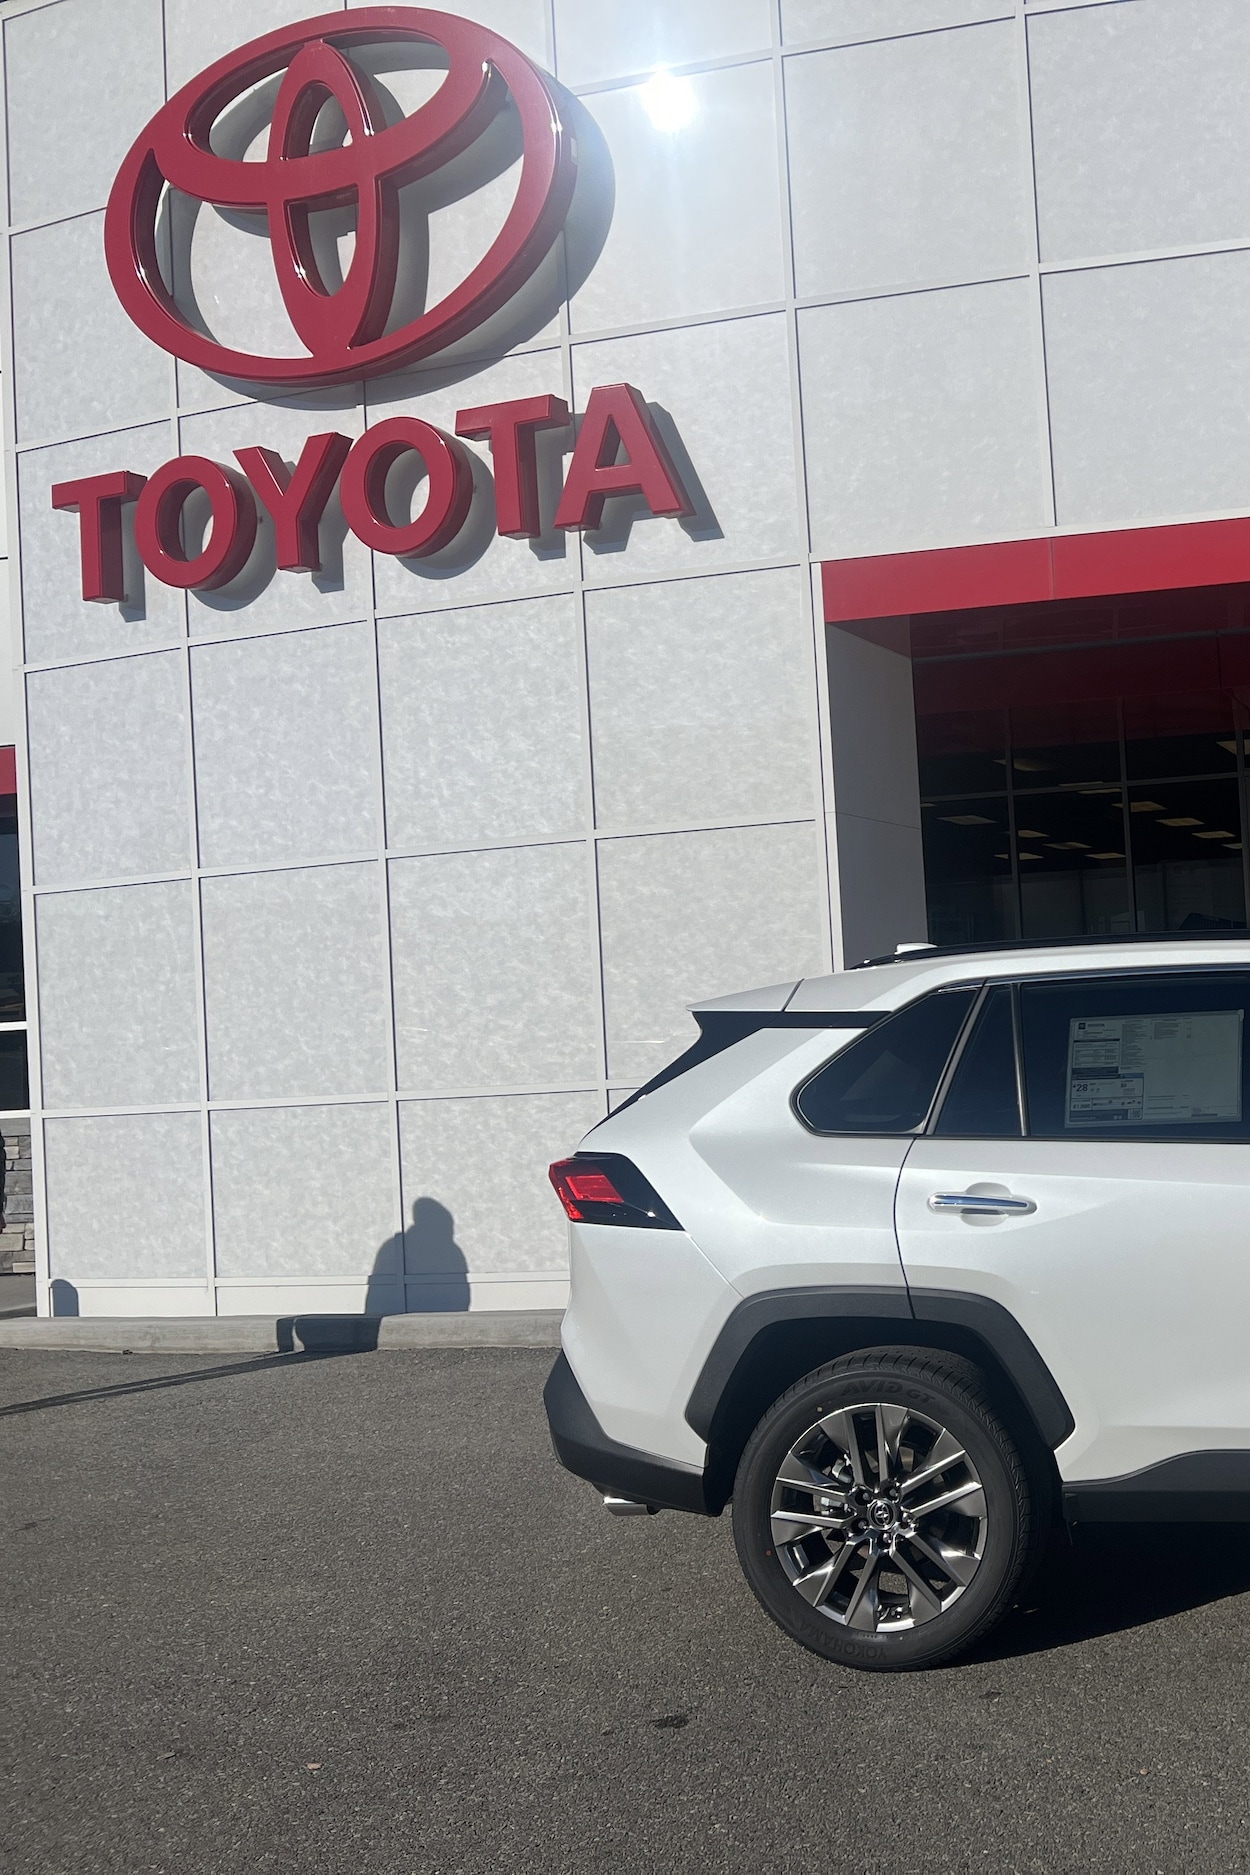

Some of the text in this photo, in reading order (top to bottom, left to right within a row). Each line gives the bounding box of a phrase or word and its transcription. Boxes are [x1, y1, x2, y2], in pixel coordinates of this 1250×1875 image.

[51, 382, 697, 604] TOYOTA
[1076, 1083, 1088, 1092] 28
[840, 1379, 936, 1404] AVID GT
[799, 1619, 887, 1660] YOKOHAMA
